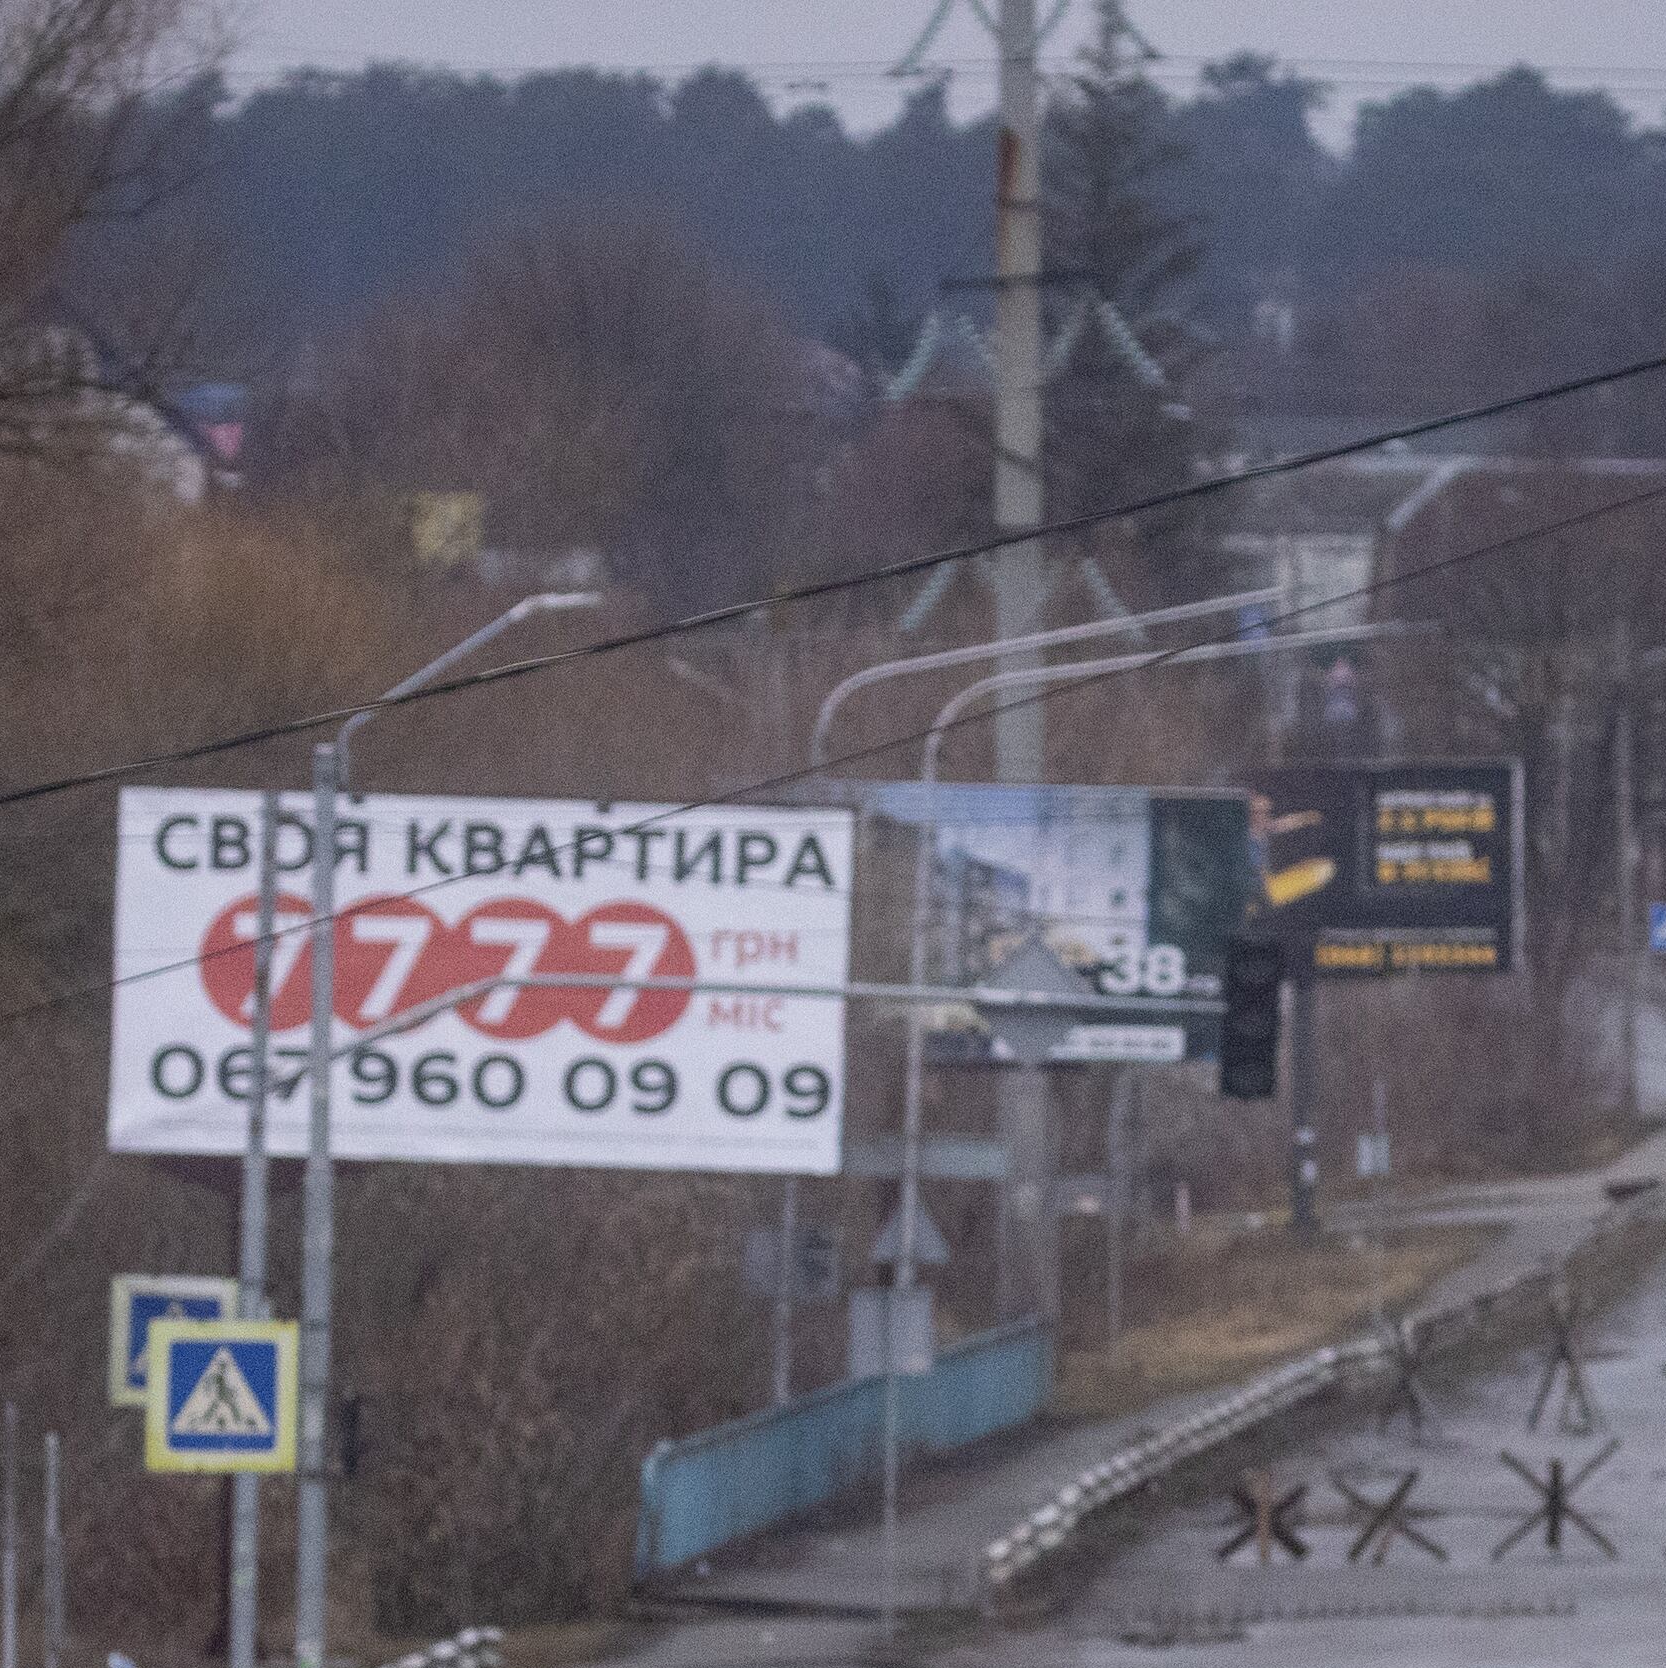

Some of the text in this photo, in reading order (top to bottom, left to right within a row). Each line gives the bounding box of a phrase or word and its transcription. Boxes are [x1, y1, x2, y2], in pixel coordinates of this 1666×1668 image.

[155, 814, 834, 889] СВОЯ КВАРТИРА
[232, 910, 670, 1029] 7777
[1099, 946, 1187, 996] 38
[151, 1041, 831, 1121] 067 960 09 09
